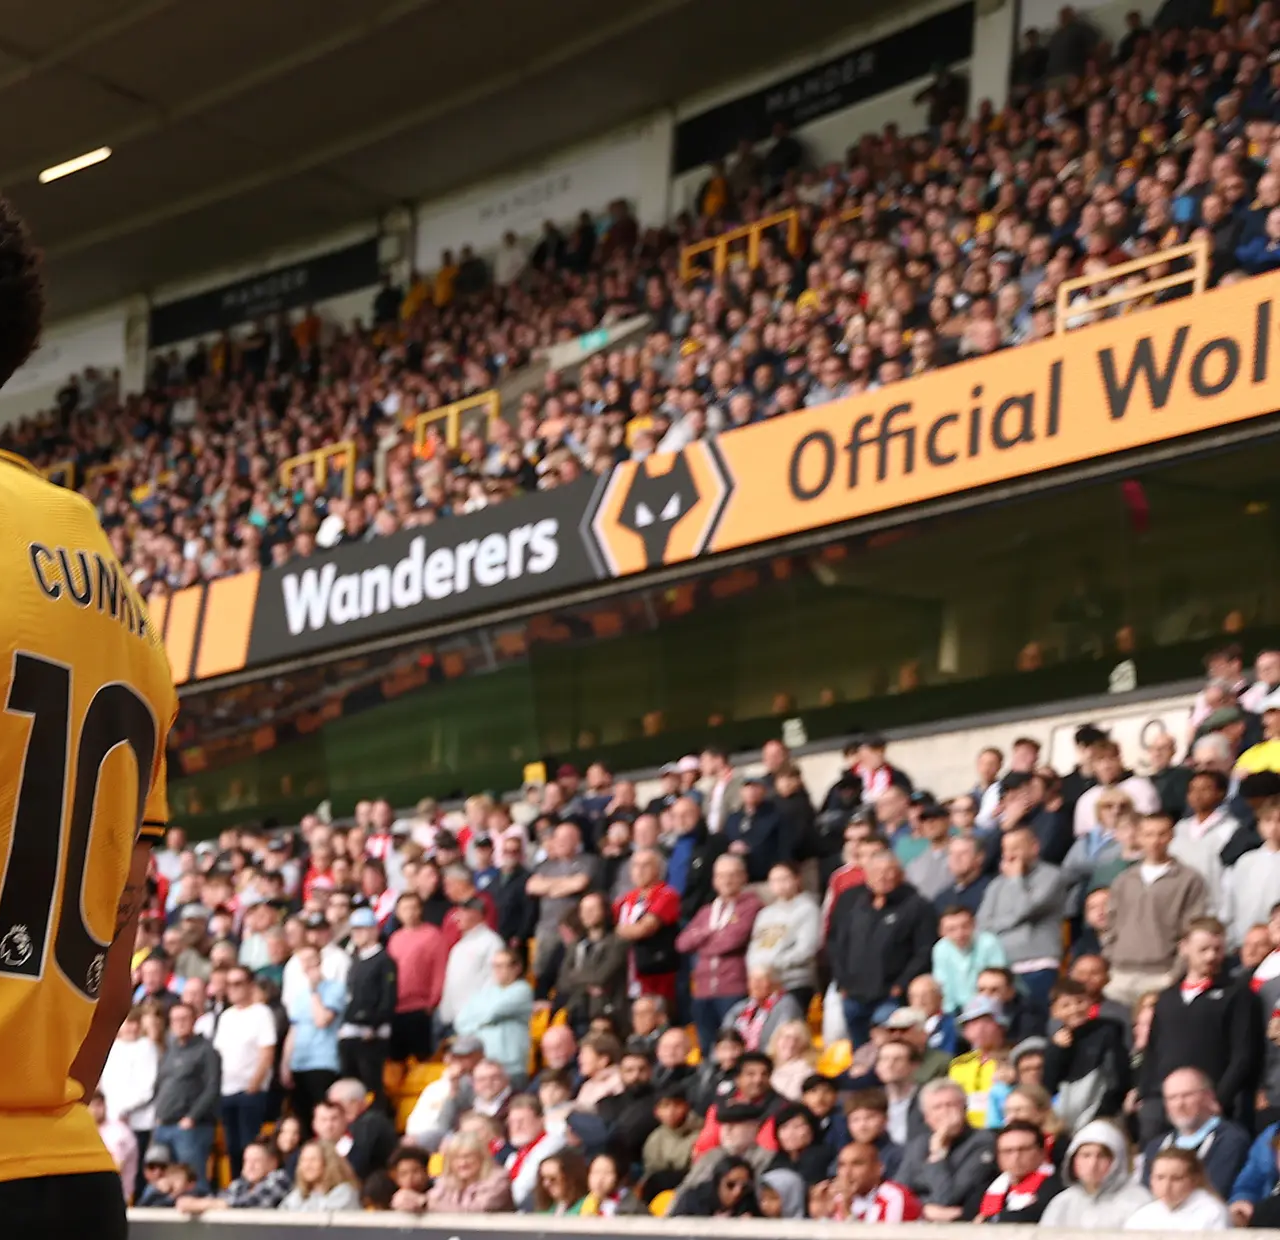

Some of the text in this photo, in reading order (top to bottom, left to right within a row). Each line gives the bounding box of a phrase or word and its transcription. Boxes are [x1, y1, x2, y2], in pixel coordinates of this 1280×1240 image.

[788, 298, 1280, 501] Official Wol
[28, 542, 147, 638] CUNH
[280, 517, 560, 636] Wanderers
